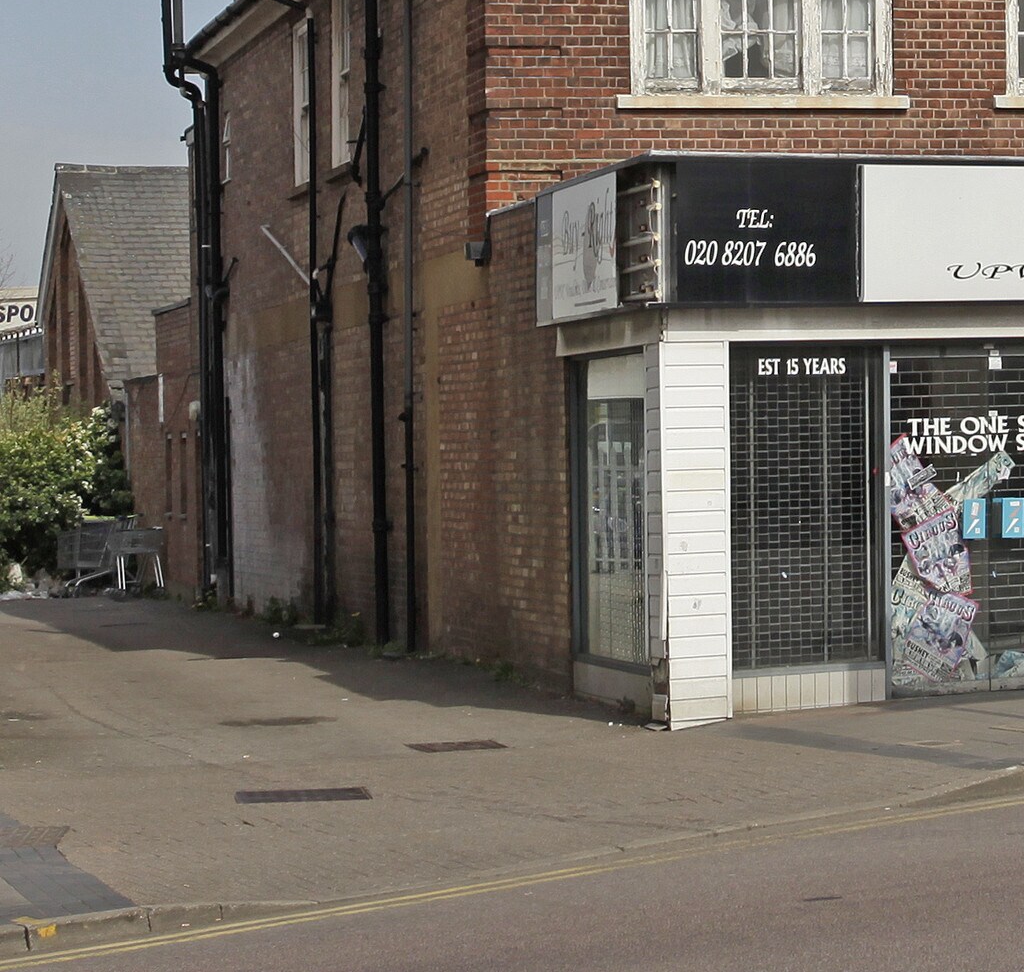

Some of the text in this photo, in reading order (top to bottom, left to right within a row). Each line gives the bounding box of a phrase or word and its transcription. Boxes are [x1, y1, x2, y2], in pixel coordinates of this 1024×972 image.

[736, 208, 774, 228] TEL:
[684, 240, 816, 267] 020 8207 6886
[758, 357, 846, 375] EST 15 YEARS
[907, 417, 952, 436] THE
[960, 415, 1010, 435] ONE
[903, 434, 1008, 455] WINDOW
